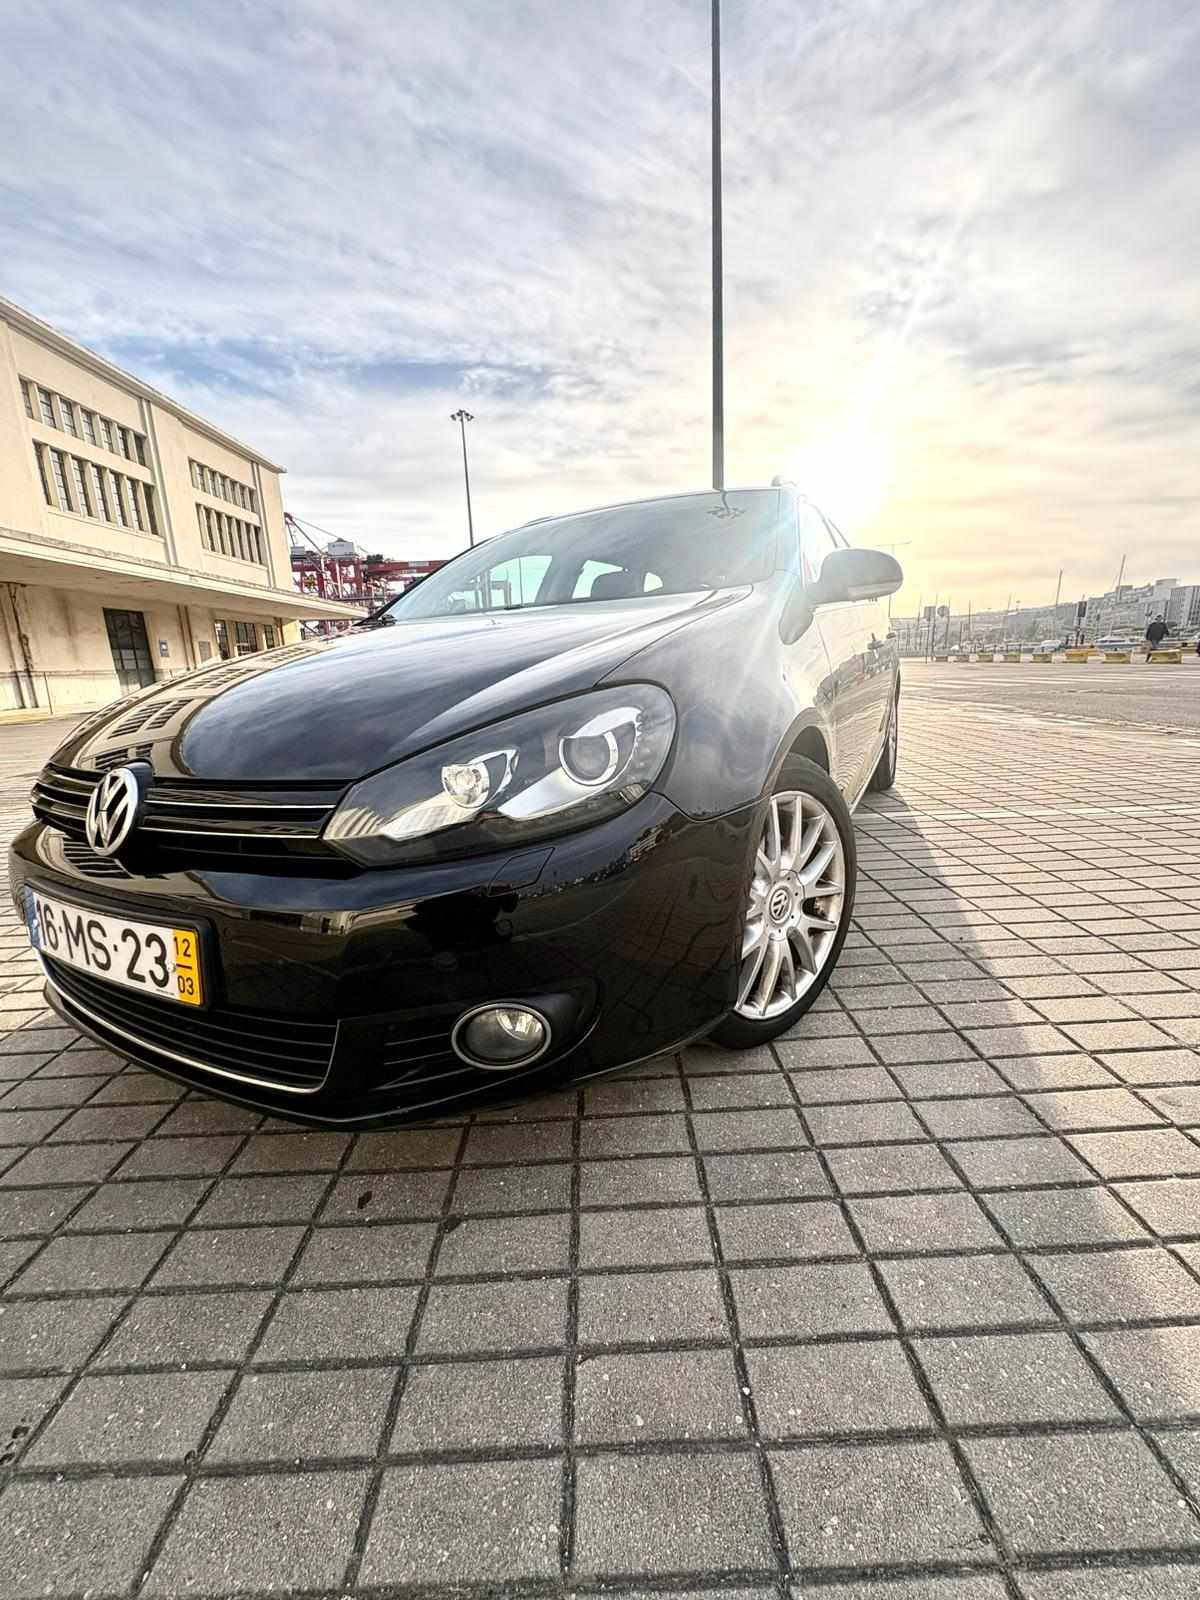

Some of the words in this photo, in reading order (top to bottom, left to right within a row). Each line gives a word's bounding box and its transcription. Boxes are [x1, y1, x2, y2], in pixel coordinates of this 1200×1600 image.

[86, 768, 139, 856] VW
[174, 936, 192, 958] 12
[177, 975, 195, 996] 03
